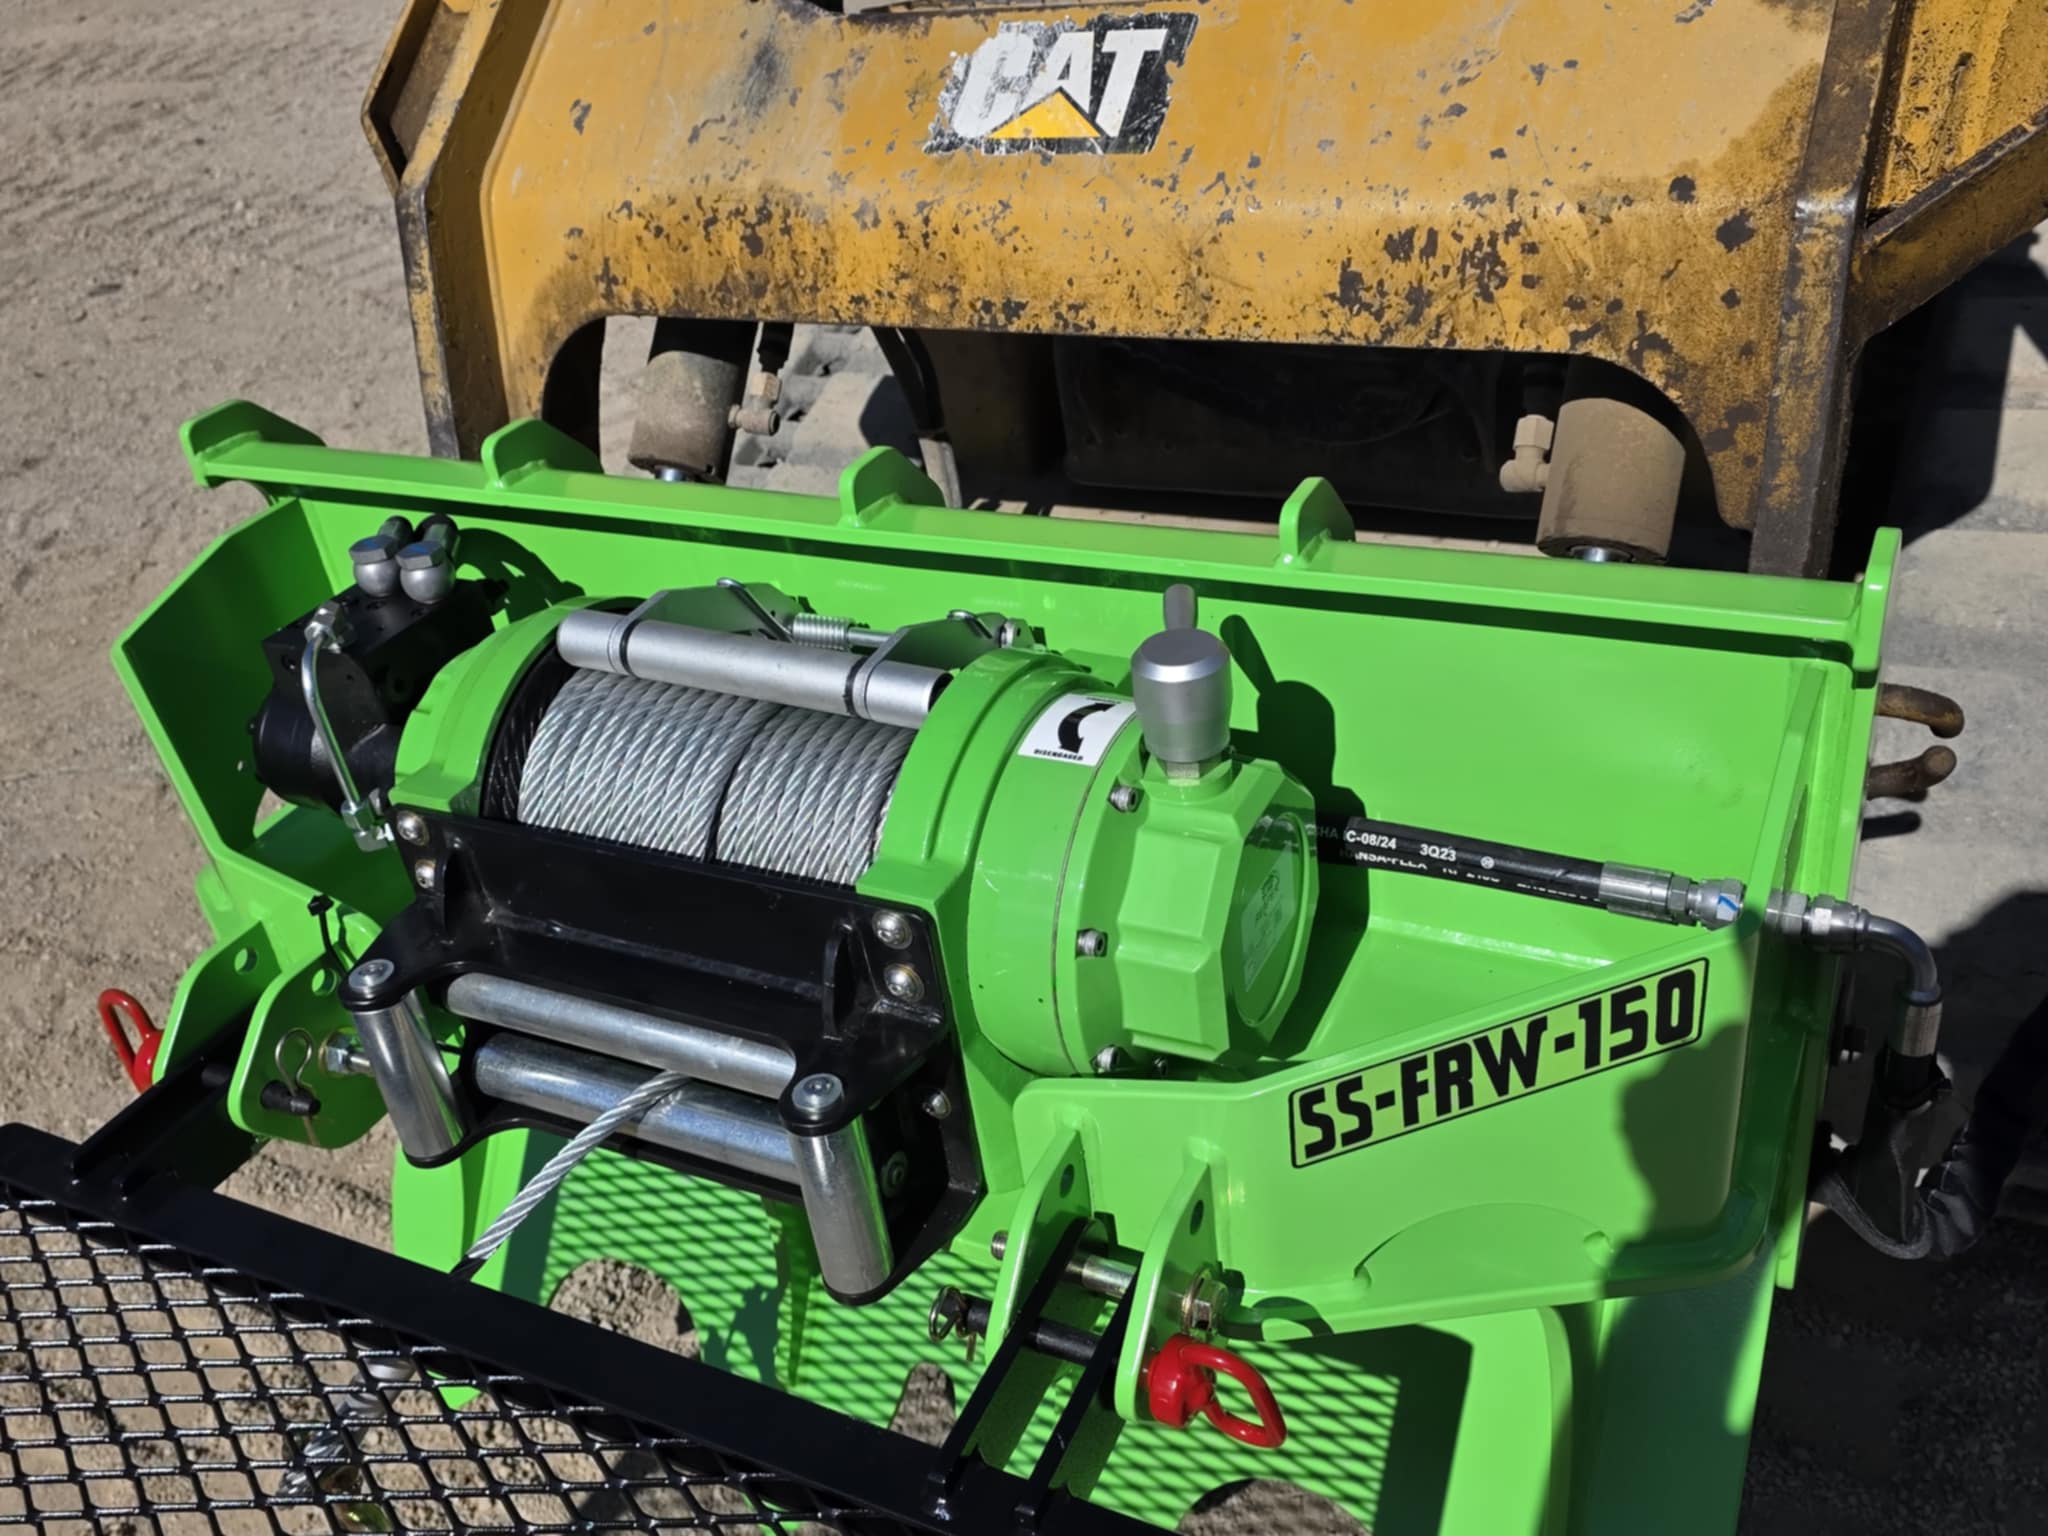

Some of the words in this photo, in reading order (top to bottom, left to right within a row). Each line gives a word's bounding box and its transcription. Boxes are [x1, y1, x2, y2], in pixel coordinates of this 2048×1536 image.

[951, 28, 1168, 138] CAT
[1419, 843, 1457, 862] 3Q23
[1299, 969, 1696, 1160] SS-FRW-150
